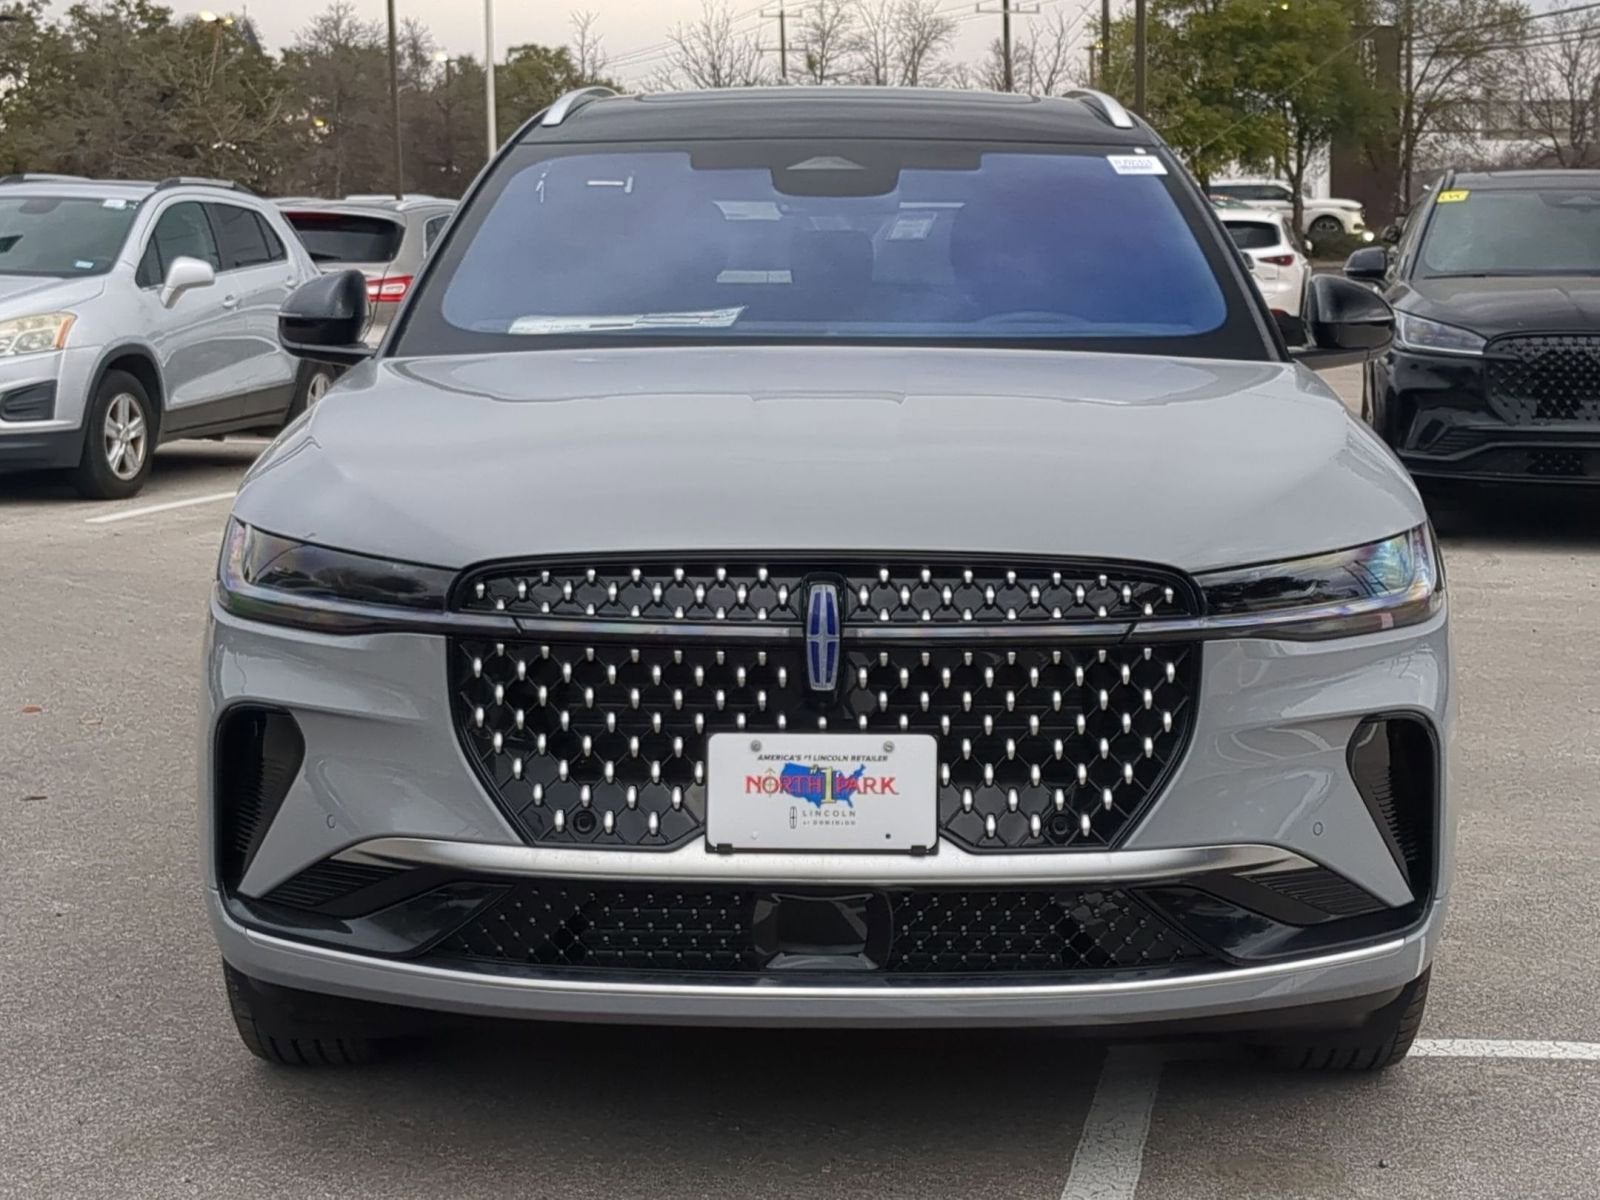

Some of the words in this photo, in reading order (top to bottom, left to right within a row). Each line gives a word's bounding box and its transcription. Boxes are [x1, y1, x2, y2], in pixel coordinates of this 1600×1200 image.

[757, 754, 801, 762] AMERICA'S
[813, 754, 848, 762] LINCOLN
[745, 775, 821, 795] NORTH
[836, 776, 900, 796] PARK
